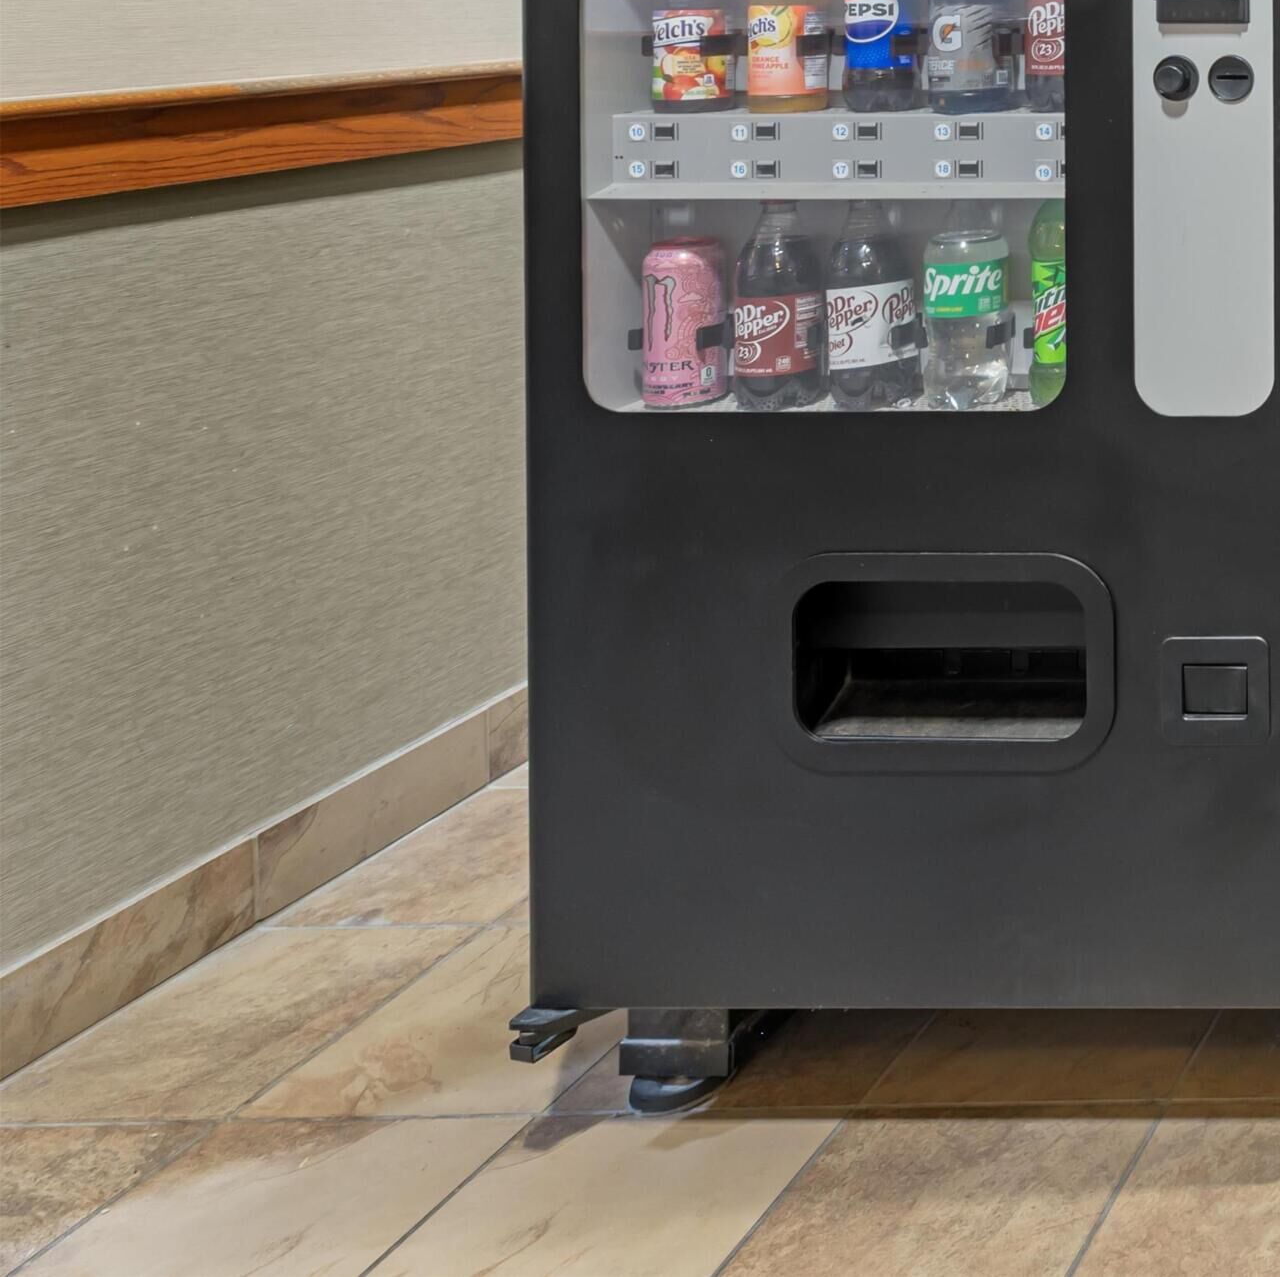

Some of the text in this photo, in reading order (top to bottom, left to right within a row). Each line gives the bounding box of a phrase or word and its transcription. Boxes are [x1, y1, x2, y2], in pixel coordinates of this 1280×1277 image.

[1029, 6, 1064, 37] Pepp
[748, 17, 776, 38] lch's
[933, 15, 963, 52] G
[1039, 43, 1052, 56] 23
[751, 55, 780, 63] ORANGE
[631, 127, 644, 137] 10
[735, 128, 745, 138] 11
[835, 127, 847, 136] 12
[937, 127, 948, 137] 13
[1038, 127, 1051, 136] 14
[631, 165, 643, 174] 15
[734, 165, 745, 174] 16
[835, 165, 847, 175] 17
[938, 164, 949, 174] 18
[1038, 168, 1050, 178] 19
[924, 265, 1002, 302] Sprite
[833, 295, 856, 314] Dr
[743, 304, 766, 323] Dr
[829, 338, 845, 352] Diet
[739, 347, 749, 359] 23
